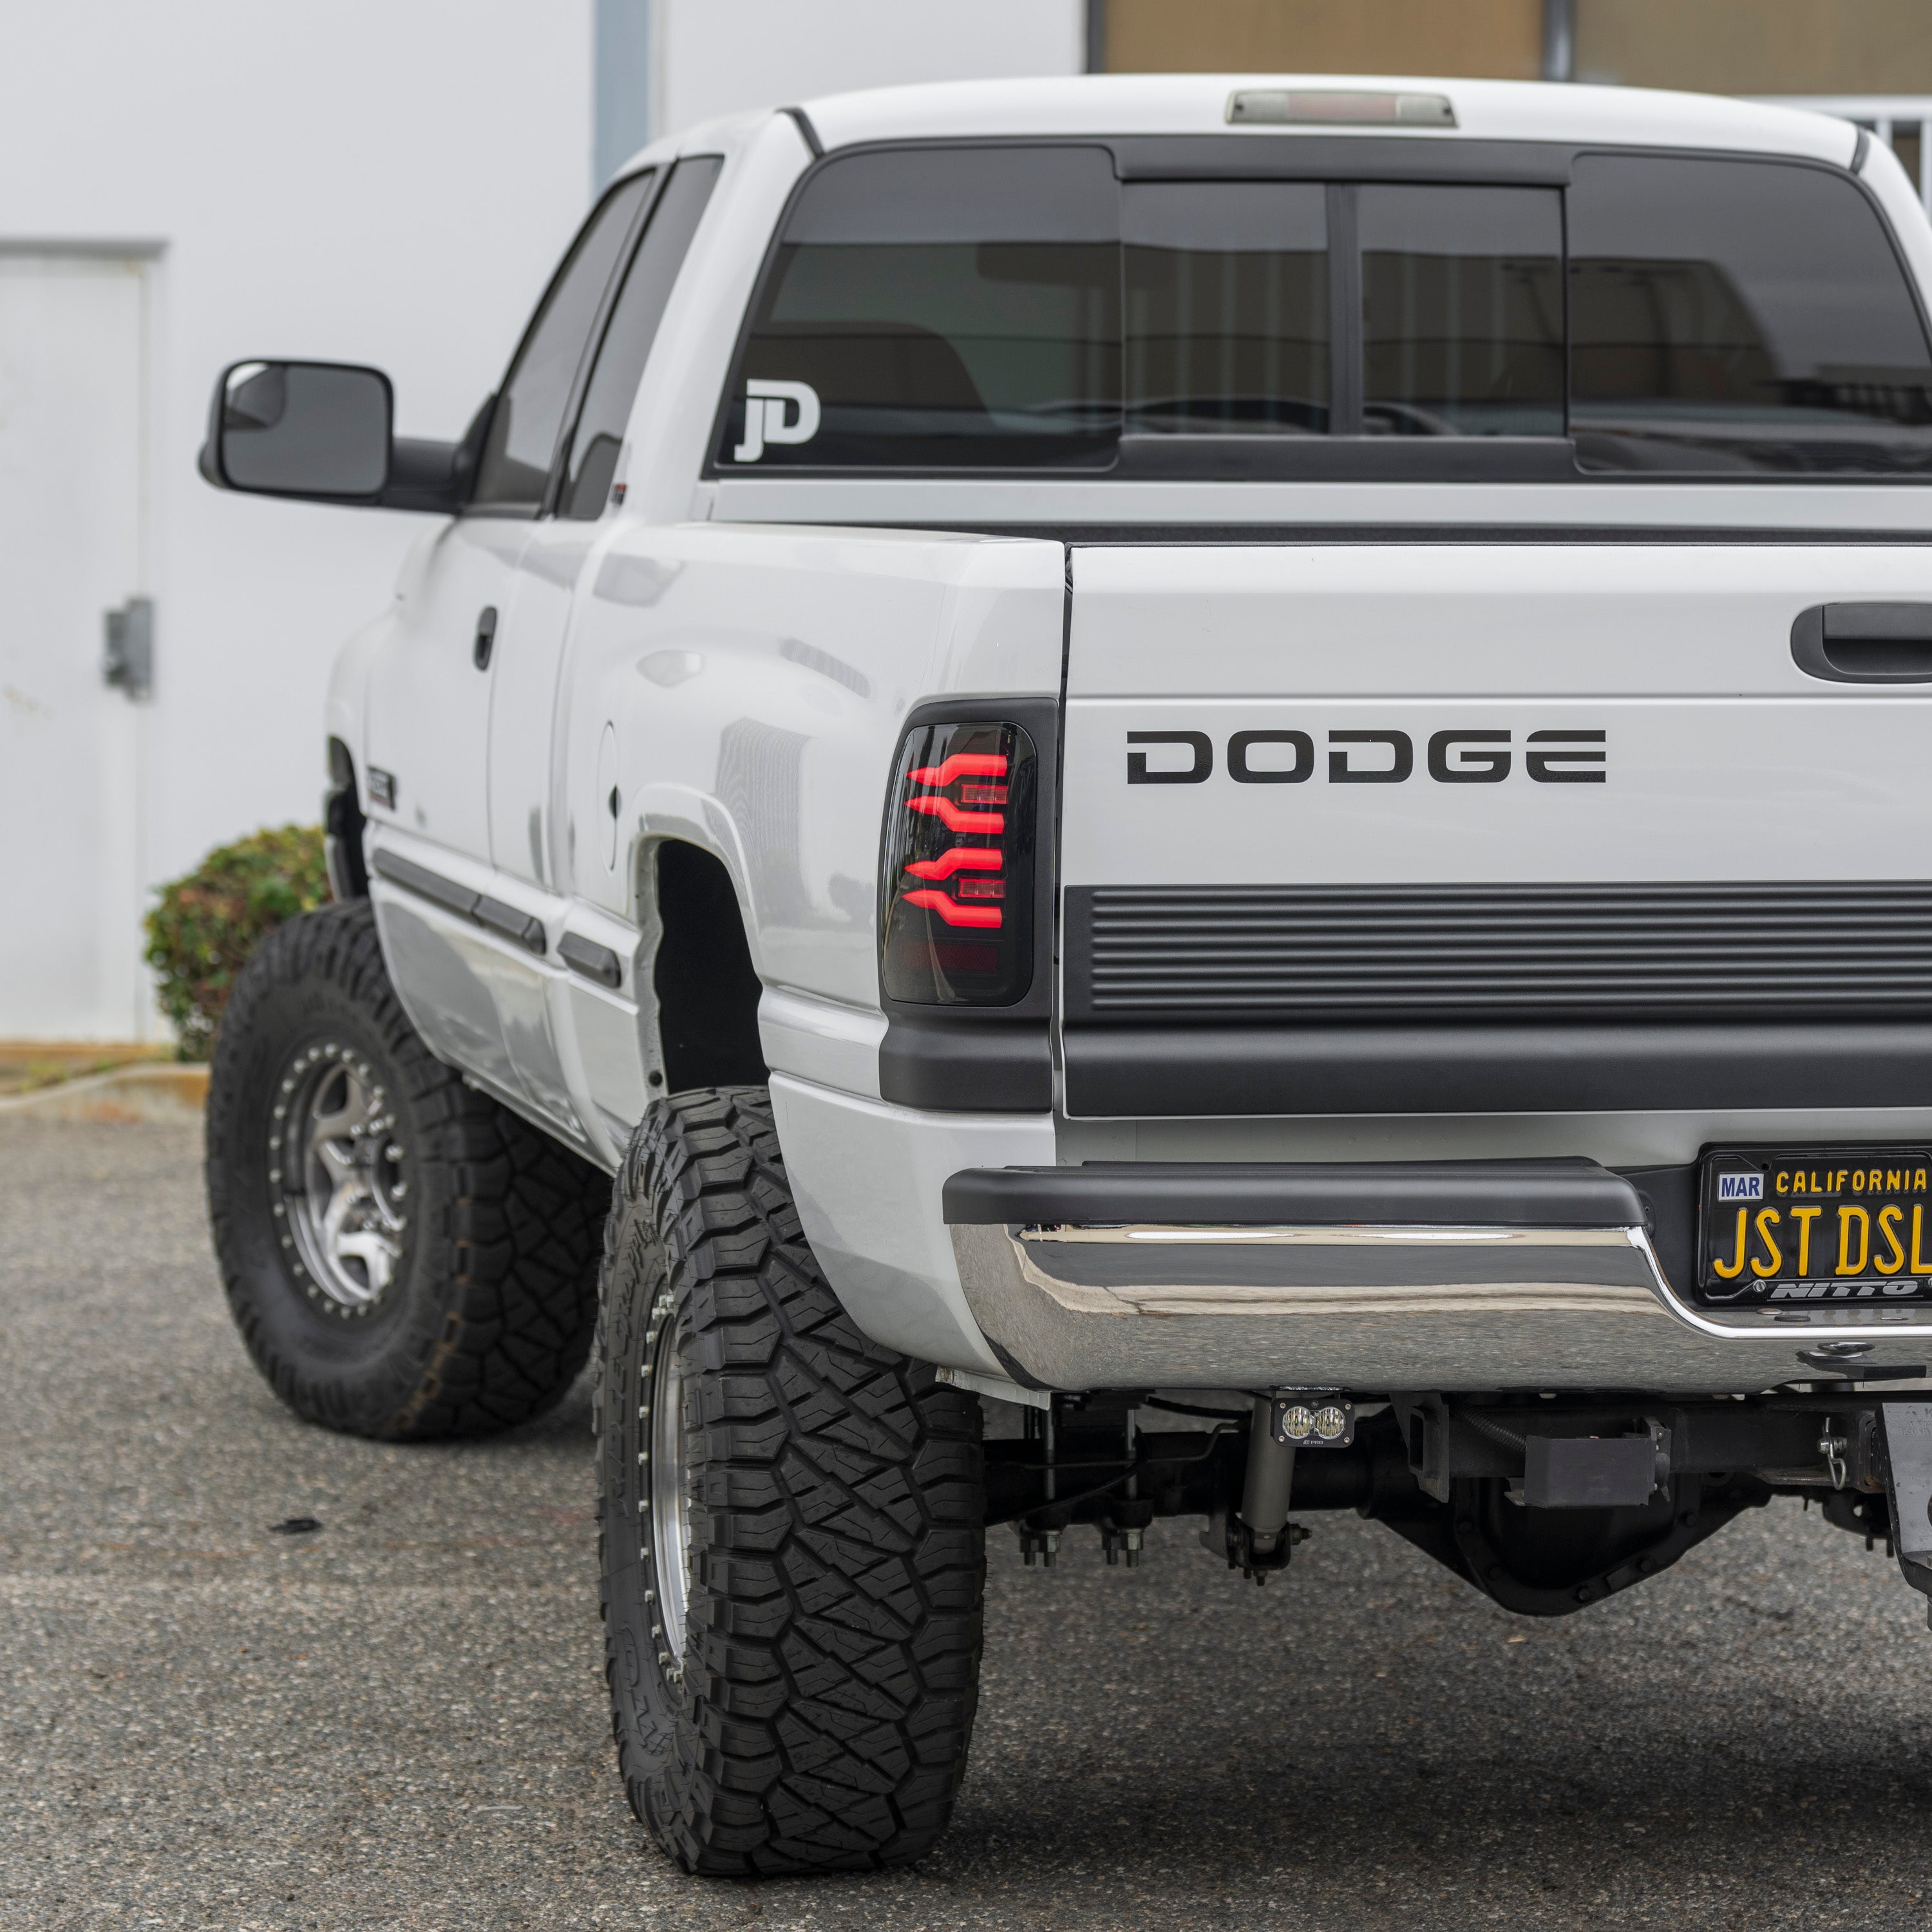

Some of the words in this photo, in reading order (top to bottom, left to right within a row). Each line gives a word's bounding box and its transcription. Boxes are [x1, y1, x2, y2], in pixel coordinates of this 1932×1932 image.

[1127, 730, 1606, 784] DODGE
[1721, 1177, 1760, 1197] MAR
[1776, 1169, 1927, 1193] CALIFORNIA
[1713, 1207, 1822, 1278] JST
[1835, 1204, 1932, 1276] DSL
[1770, 1280, 1918, 1298] NITTO
